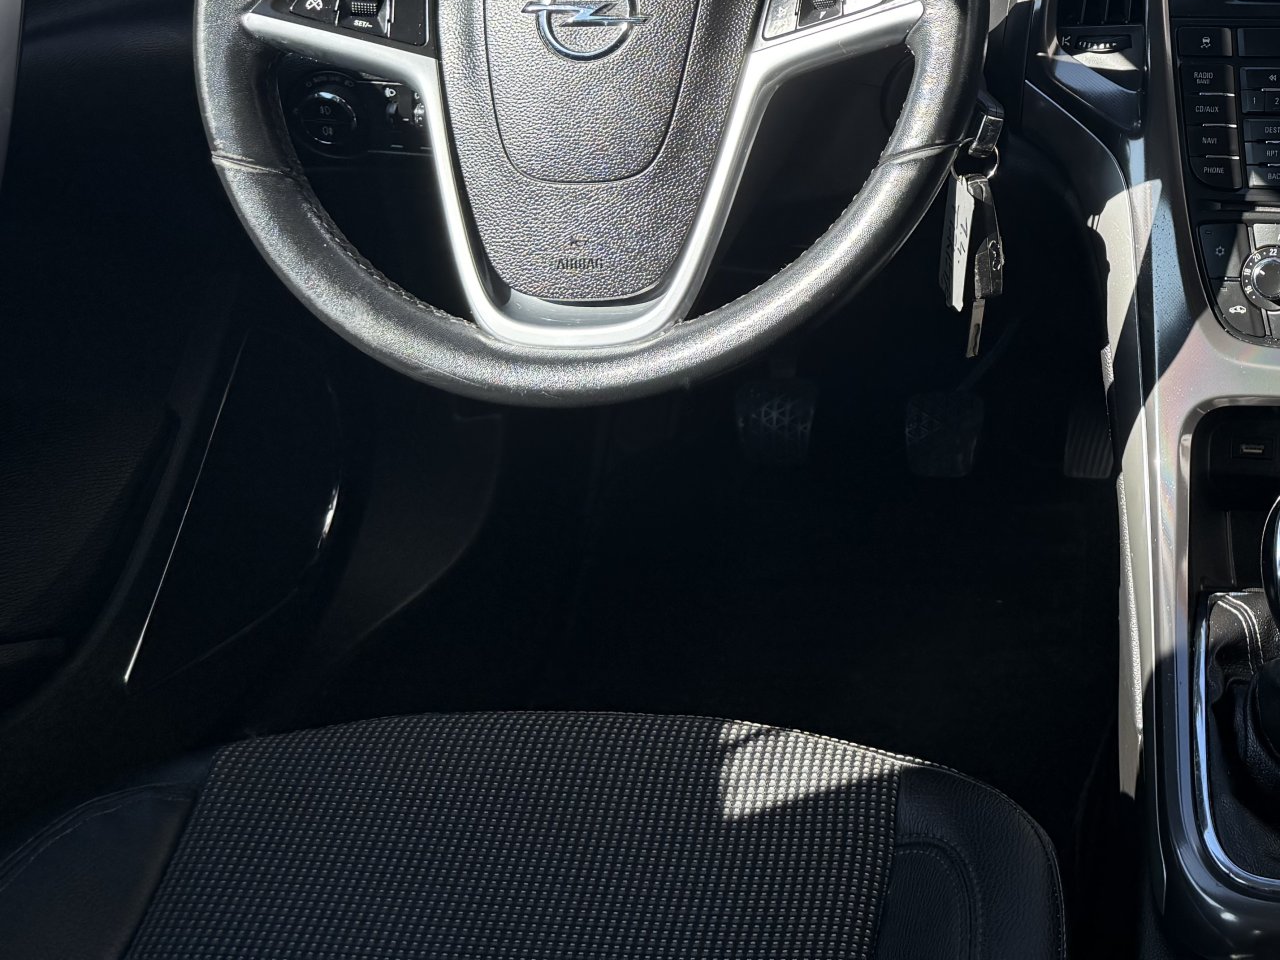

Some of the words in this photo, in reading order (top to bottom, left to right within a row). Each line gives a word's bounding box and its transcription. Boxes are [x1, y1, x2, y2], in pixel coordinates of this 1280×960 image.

[1193, 71, 1213, 79] RADIO
[1274, 97, 1279, 105] 2
[1195, 105, 1219, 113] CD/AUX
[1203, 166, 1224, 174] PHONE
[1269, 248, 1278, 256] 22
[1253, 253, 1261, 262] 20
[556, 258, 603, 270] AIRBAG
[1244, 268, 1252, 276] 18
